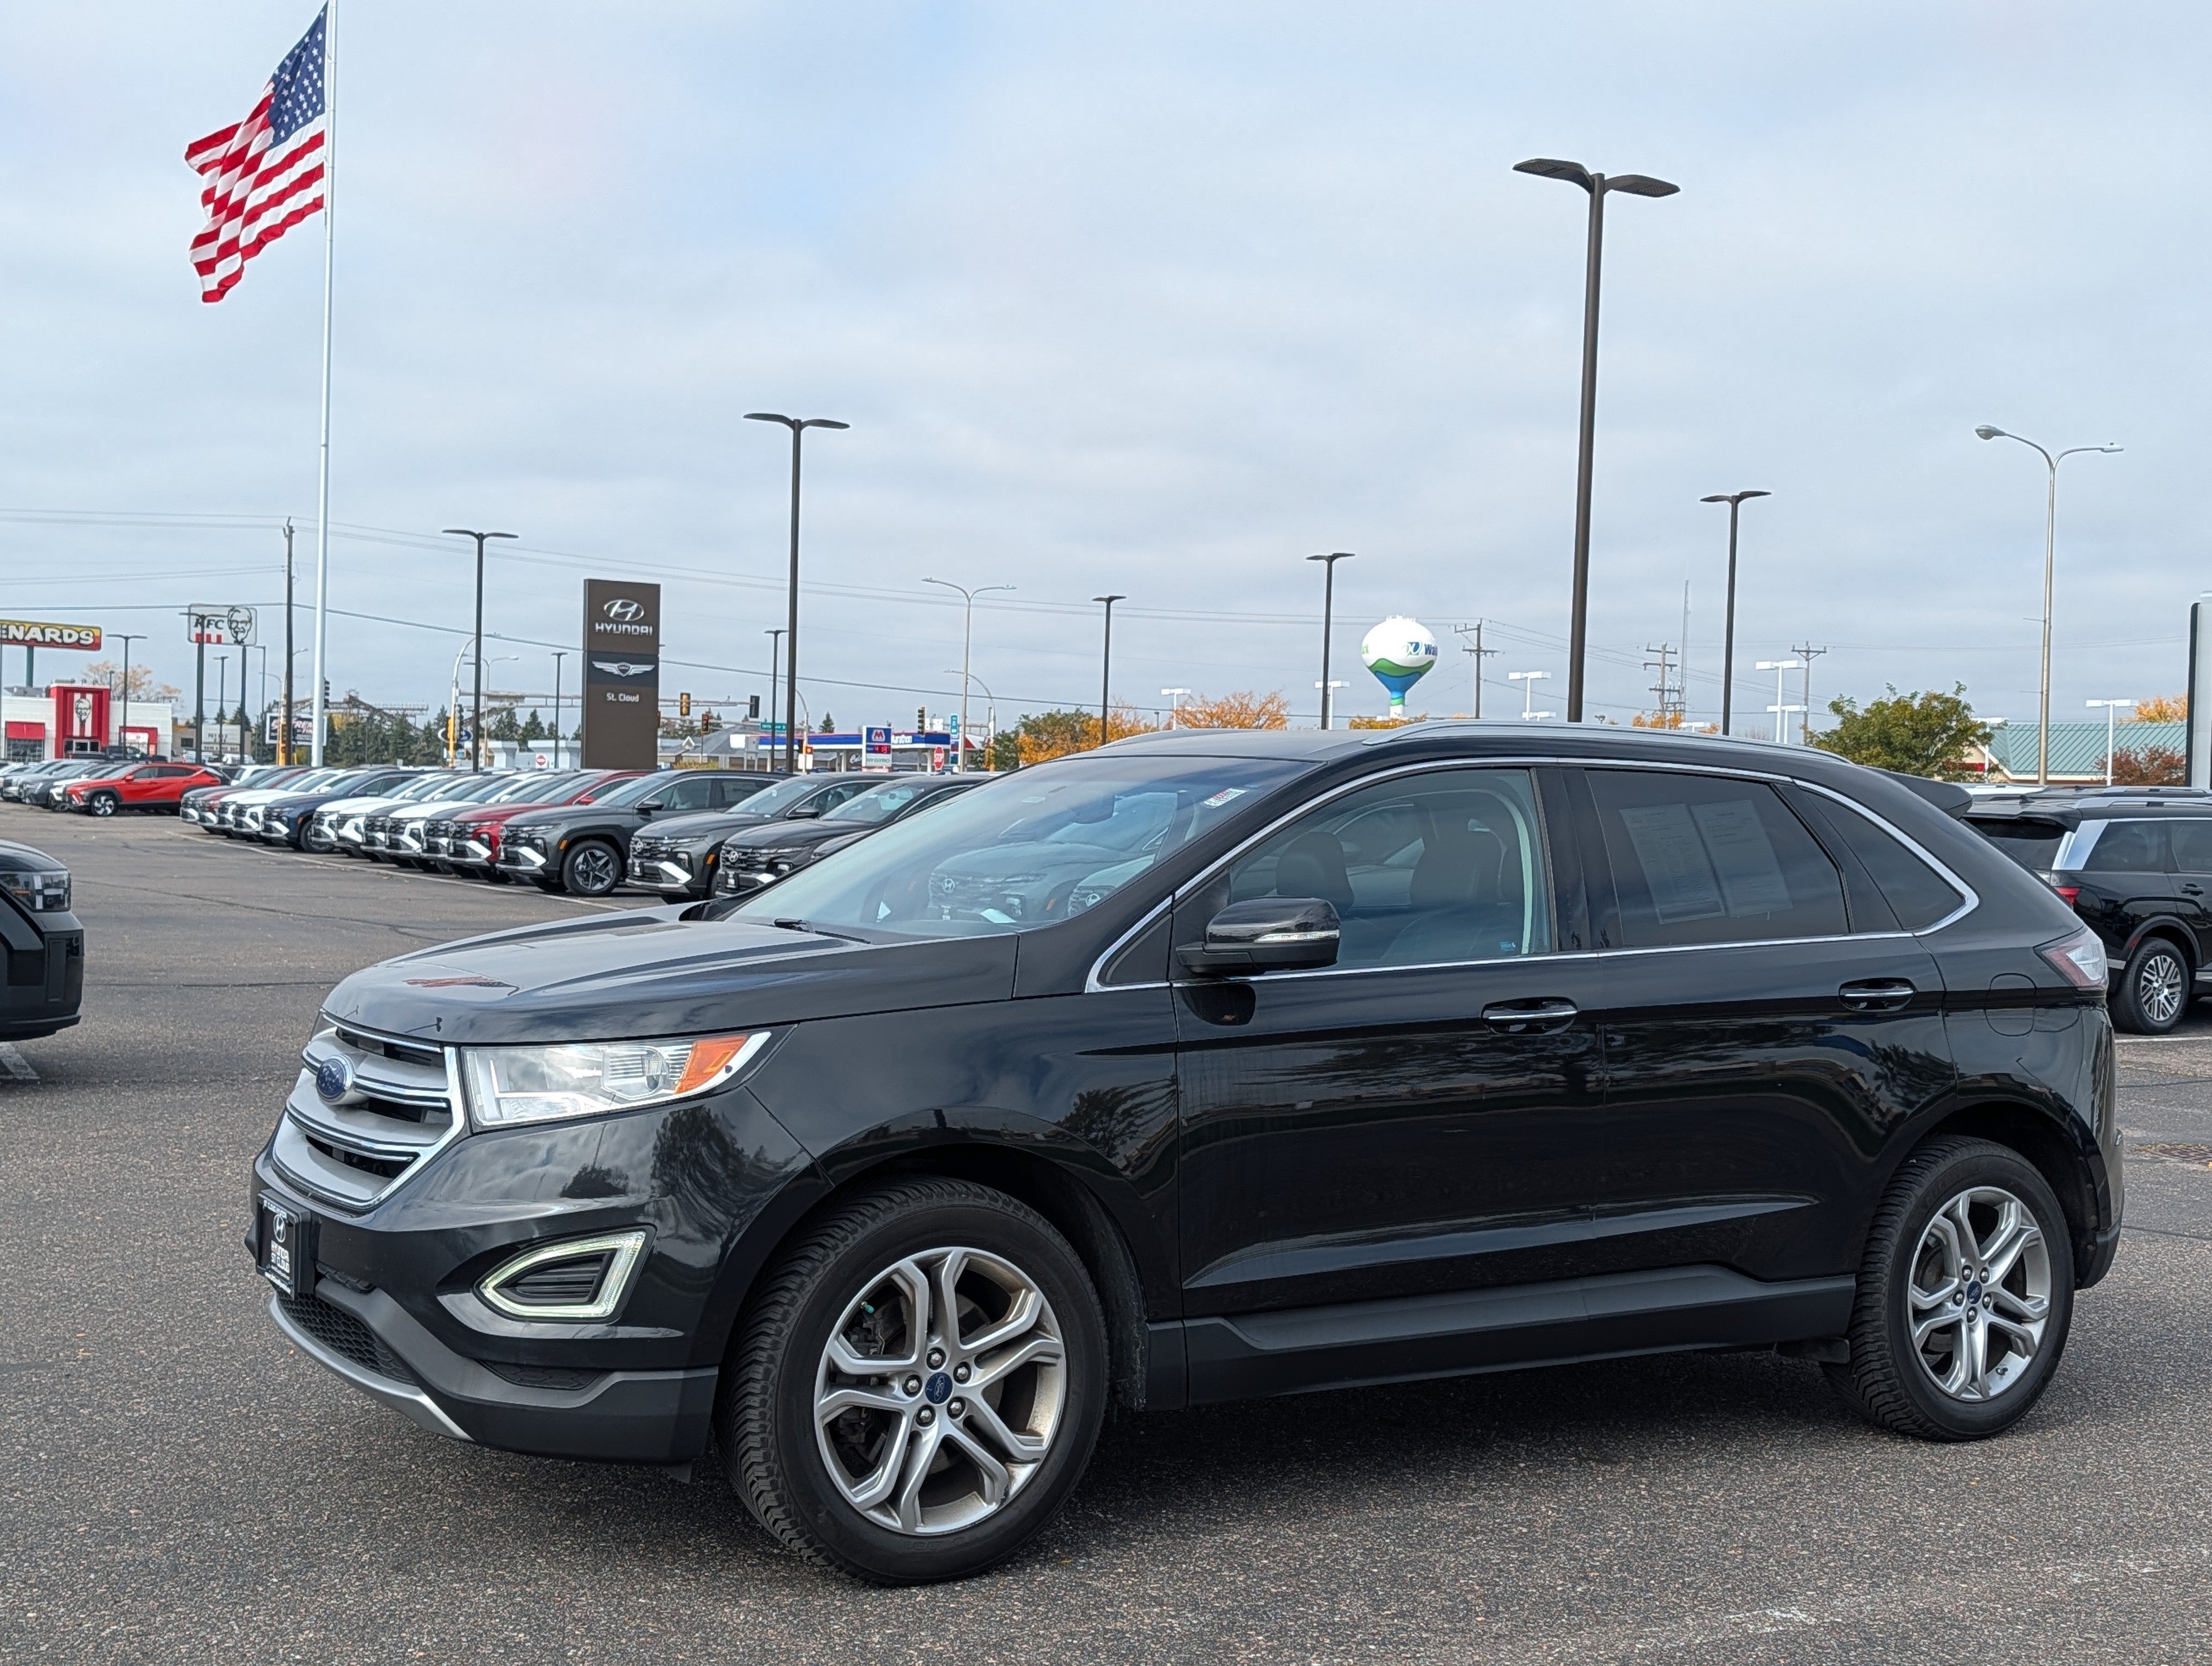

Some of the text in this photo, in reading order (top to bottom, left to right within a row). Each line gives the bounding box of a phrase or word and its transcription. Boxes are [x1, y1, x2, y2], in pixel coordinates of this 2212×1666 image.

[595, 623, 653, 636] HYUNDAI
[607, 693, 639, 702] St. Cloud
